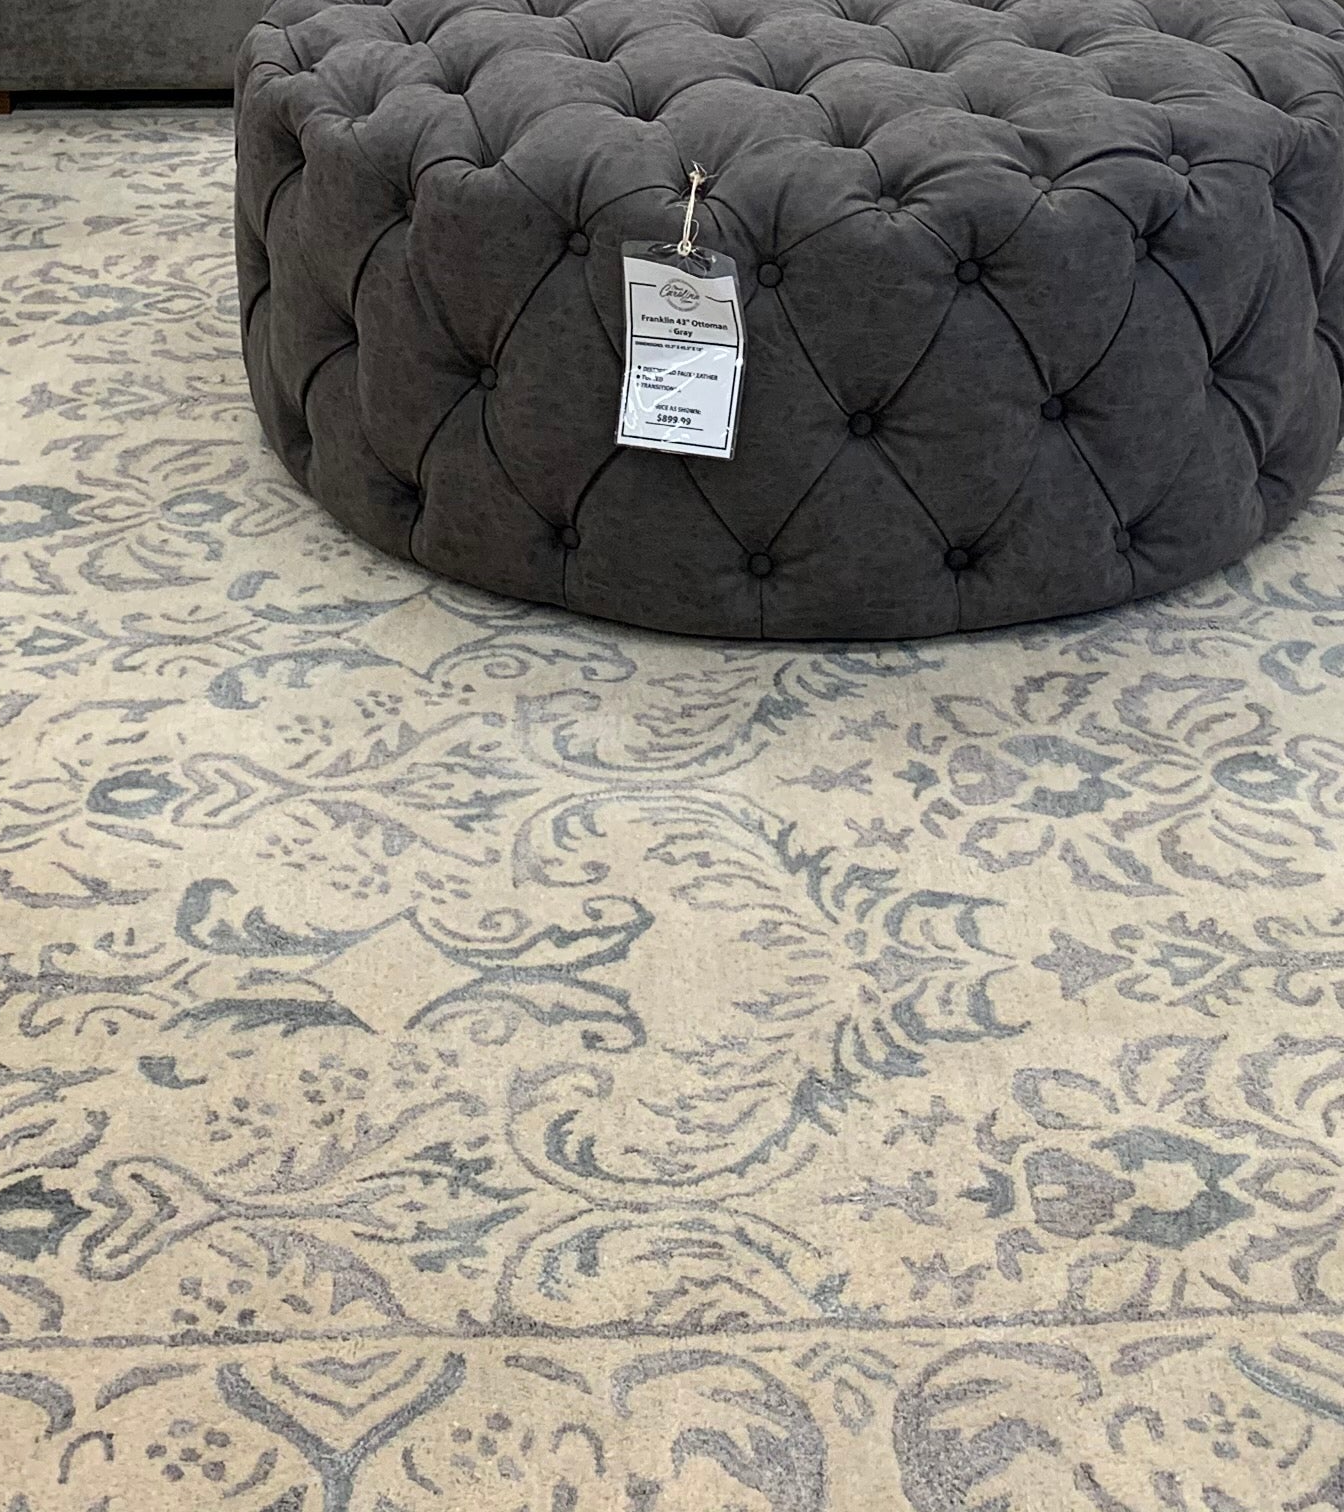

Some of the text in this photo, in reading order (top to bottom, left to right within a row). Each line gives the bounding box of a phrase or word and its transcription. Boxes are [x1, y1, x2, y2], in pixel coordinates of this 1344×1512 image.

[641, 314, 728, 331] Franklin 43" Ottoman
[673, 328, 693, 338] Gray
[656, 413, 692, 426] $899.99
